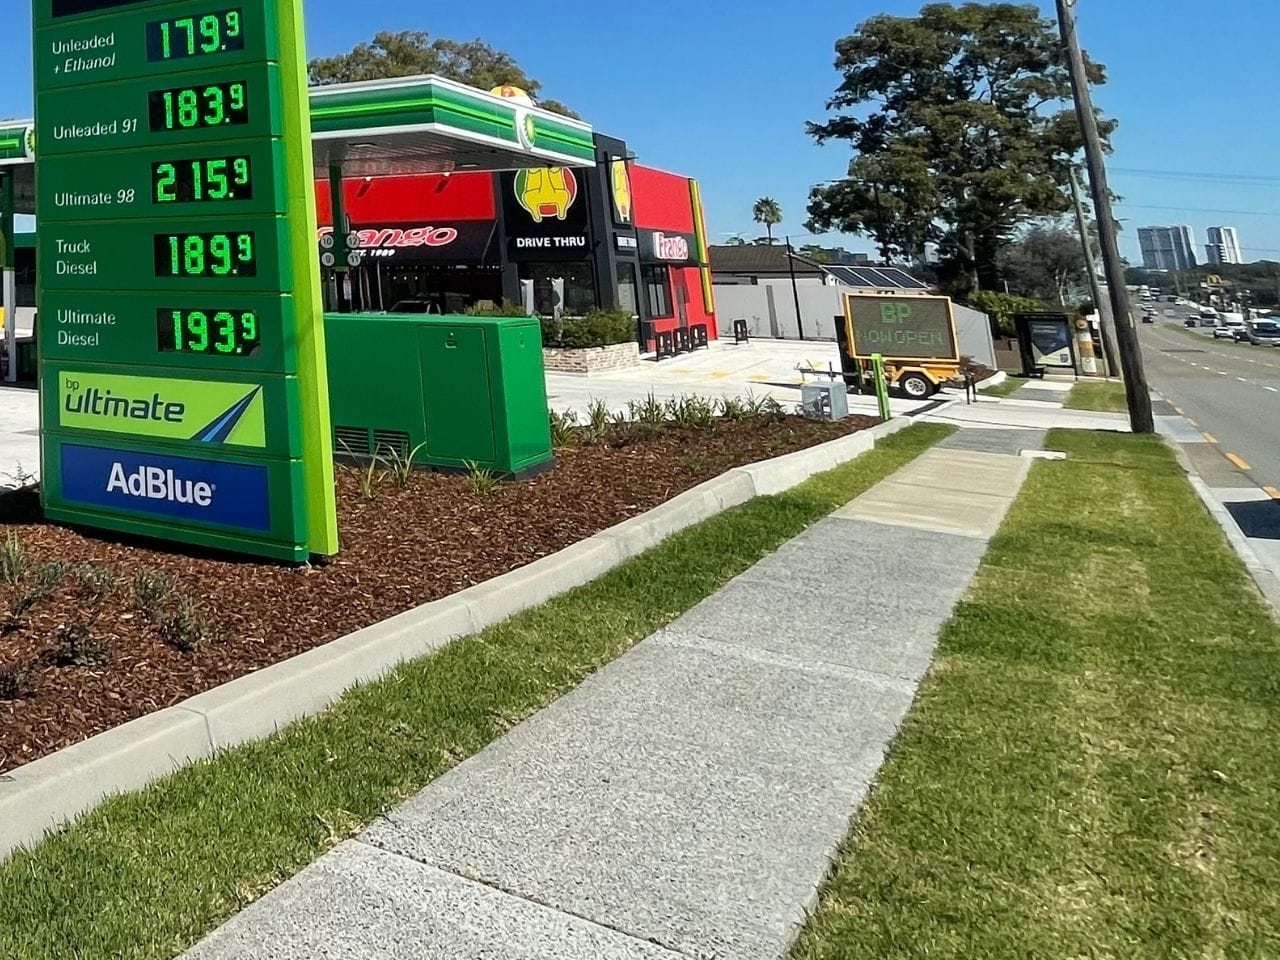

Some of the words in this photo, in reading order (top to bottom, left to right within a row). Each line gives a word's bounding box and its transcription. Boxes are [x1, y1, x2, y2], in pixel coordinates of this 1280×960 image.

[52, 32, 115, 55] Unleaded
[160, 11, 239, 58] 179.9
[63, 53, 116, 73] Ethanol
[163, 83, 244, 128] 183.9
[53, 120, 117, 139] Unleaded
[121, 118, 138, 133] 91
[54, 191, 112, 207] Ultimate
[116, 189, 135, 204] 98
[56, 239, 91, 253] Truck
[516, 237, 551, 248] DRIVE
[553, 236, 586, 247] THRU
[169, 234, 251, 275] 189.9
[56, 260, 97, 275] Diesel
[57, 309, 116, 325] Ultimate
[880, 302, 913, 324] BP
[57, 331, 99, 346] Diesel
[172, 310, 256, 353] 193.9
[895, 329, 944, 345] OPEN
[65, 377, 80, 392] bp
[65, 388, 185, 422] ultimate
